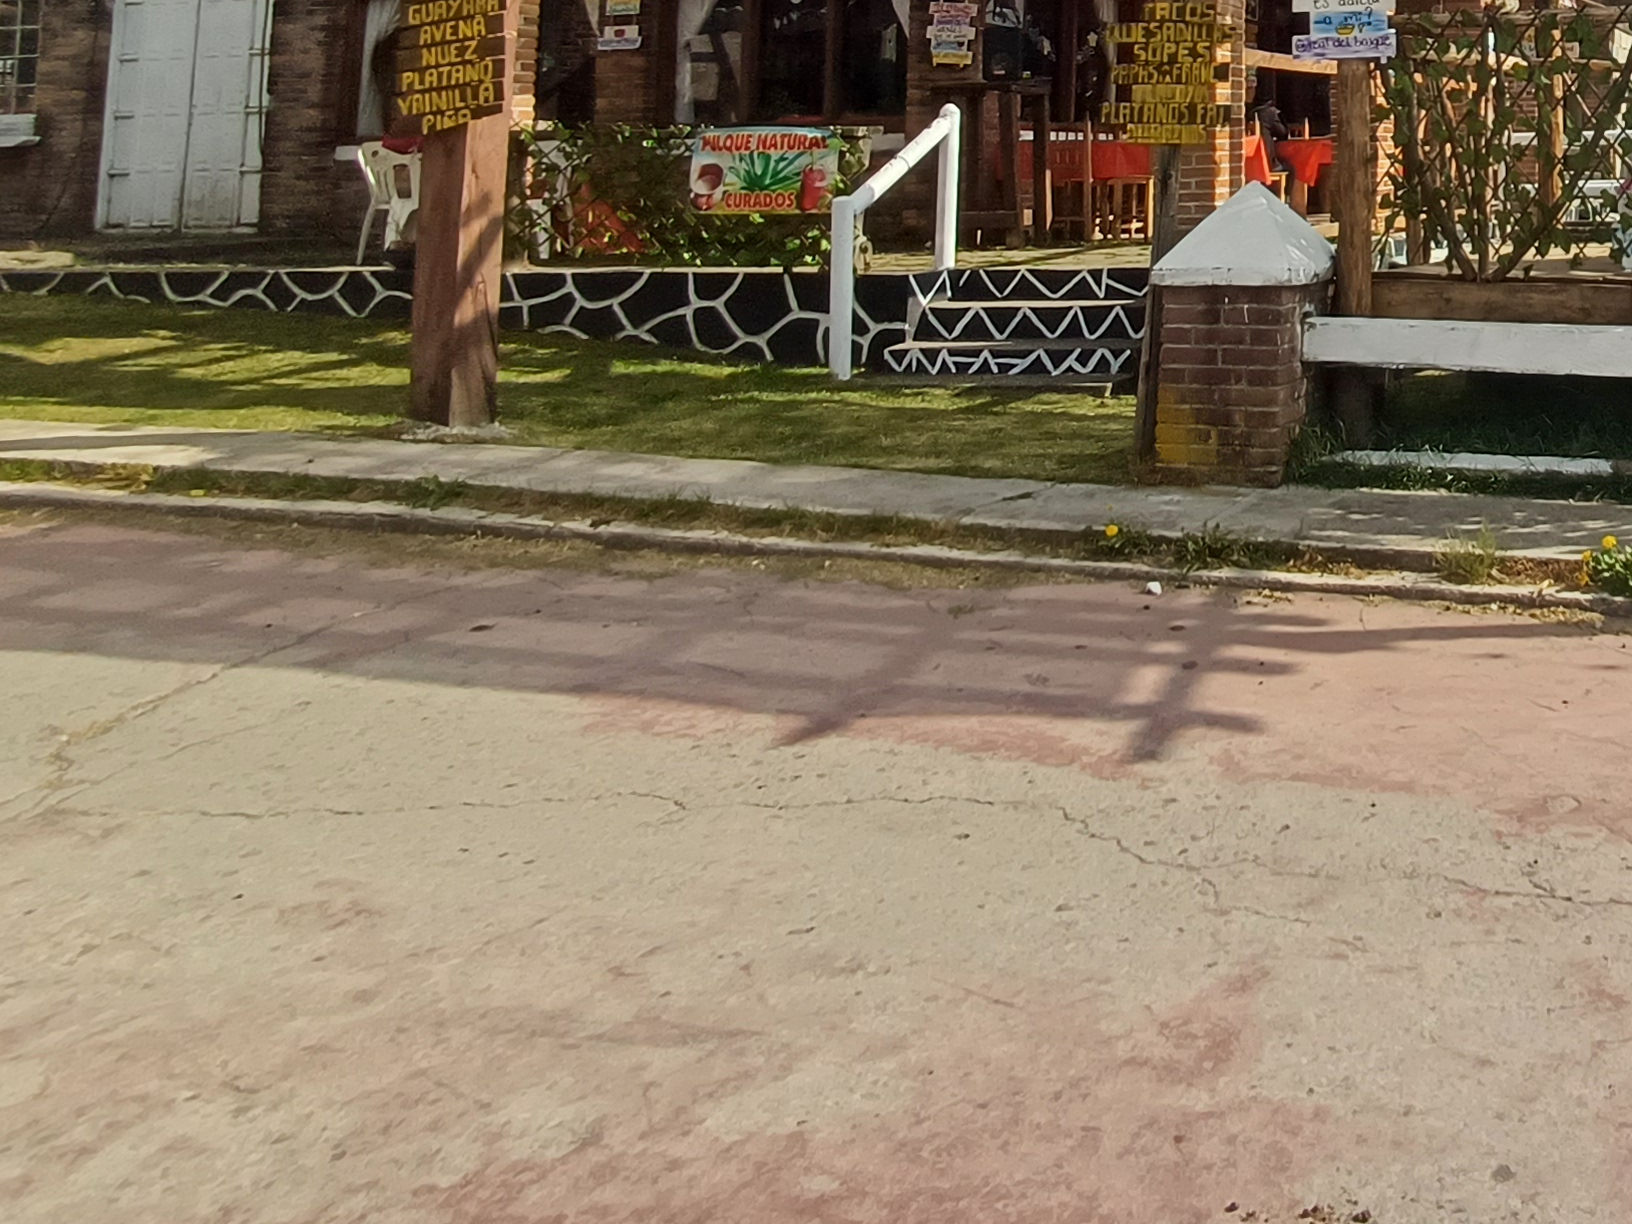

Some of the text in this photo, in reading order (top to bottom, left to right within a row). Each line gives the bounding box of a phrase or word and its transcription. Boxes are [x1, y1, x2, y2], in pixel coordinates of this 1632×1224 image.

[1144, 2, 1215, 23] TACOS
[419, 15, 486, 46] AVENA
[1106, 22, 1236, 44] QUESADILLAS
[422, 40, 478, 67] NUEZ
[1133, 42, 1211, 63] SOPES
[402, 60, 493, 92] PLATANO
[397, 83, 494, 116] VAINILLA
[422, 108, 471, 135] PIÑA
[1101, 101, 1189, 124] PLATANOS
[701, 133, 829, 153] PULQUE NATURAL
[725, 192, 795, 209] CURADOS
